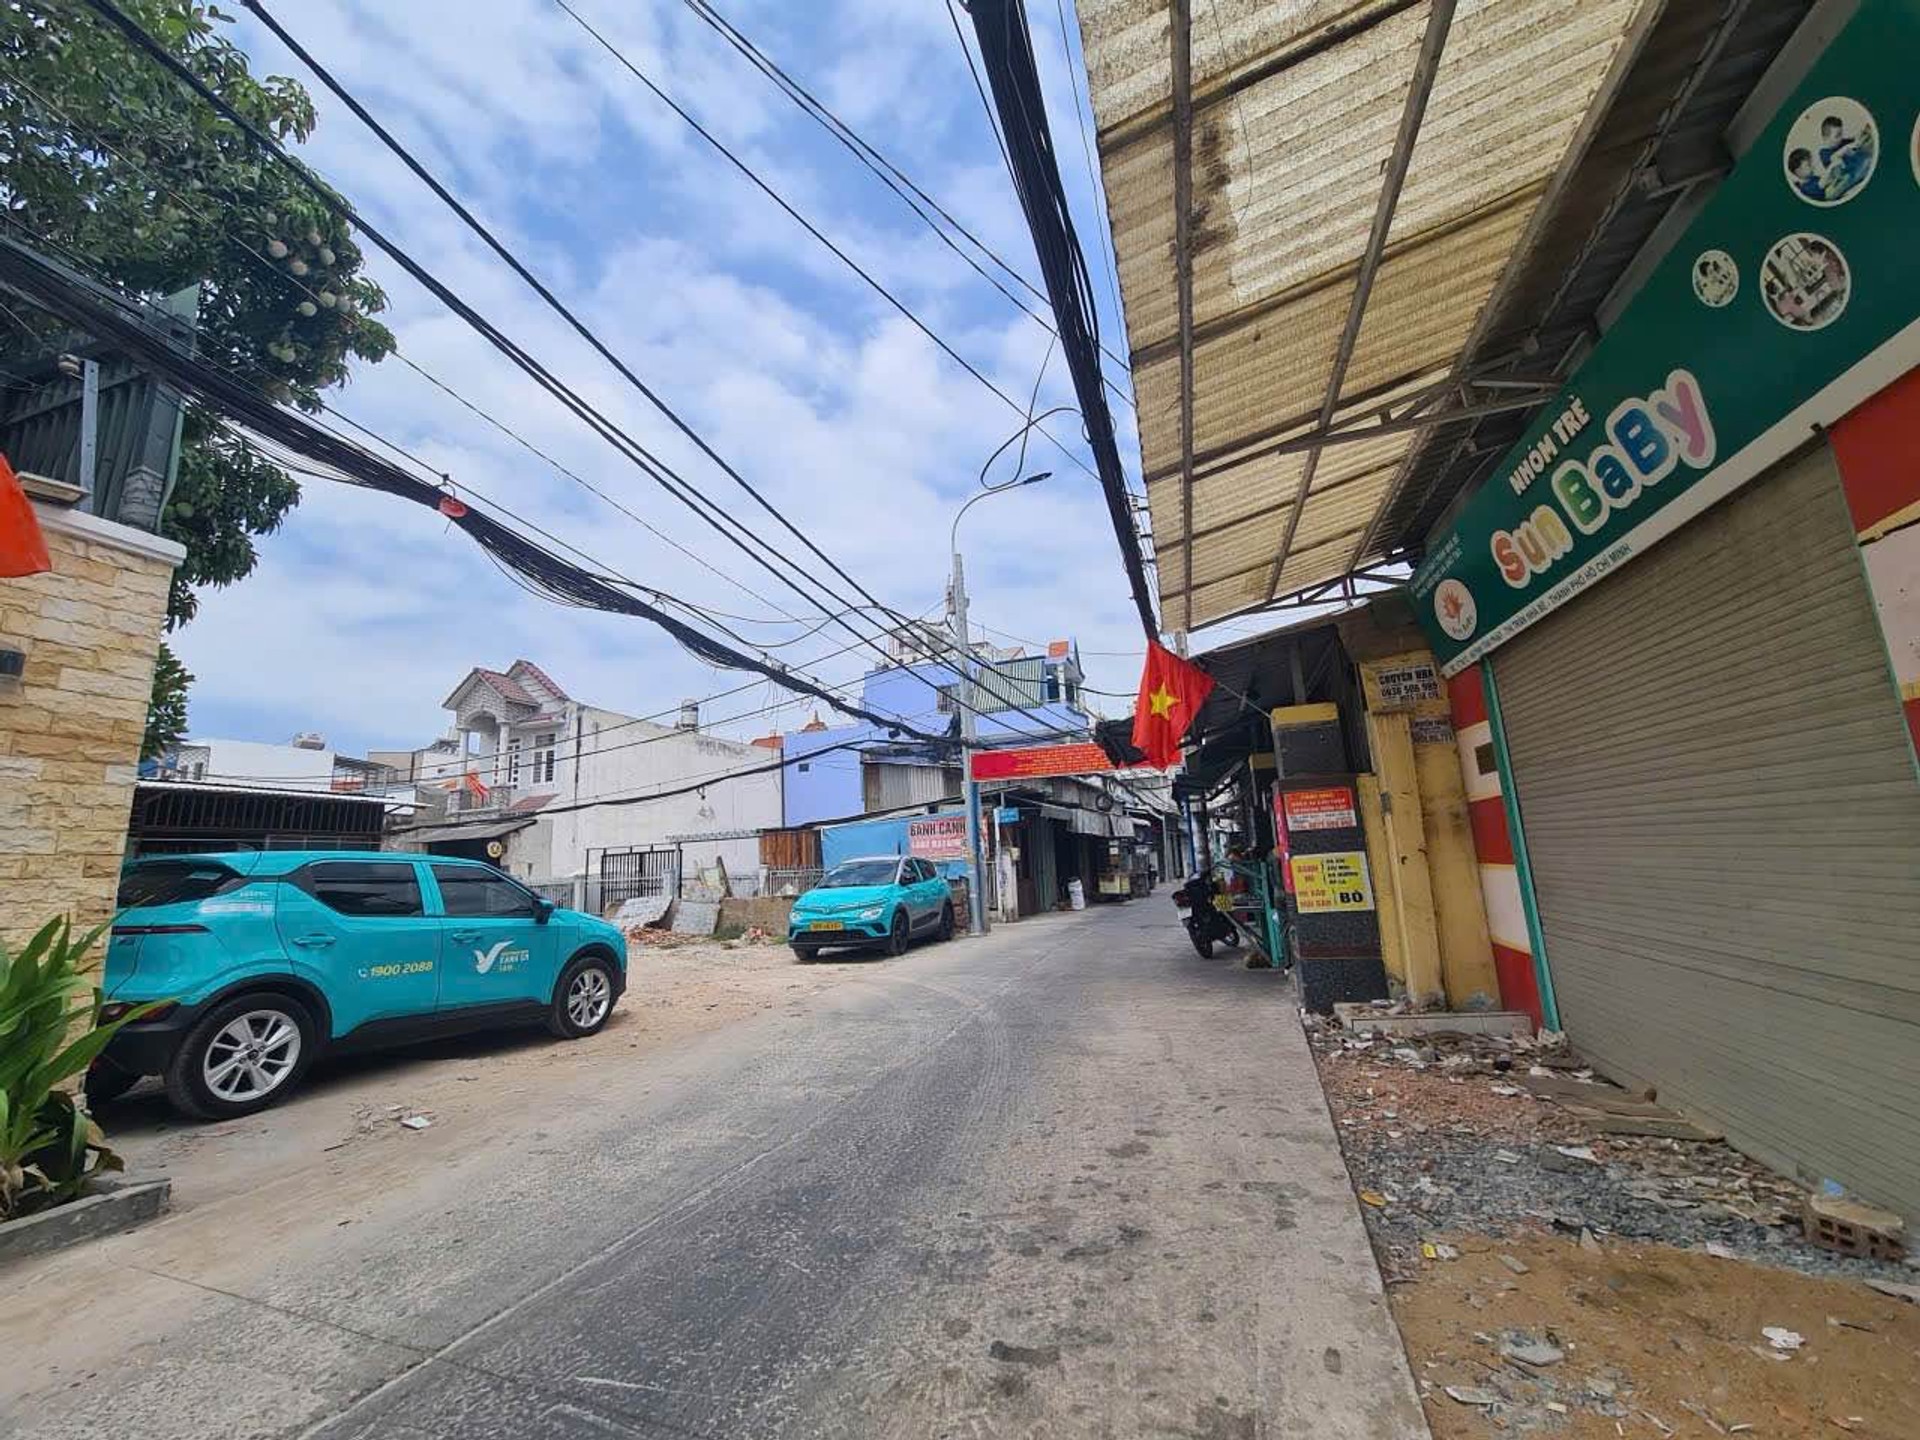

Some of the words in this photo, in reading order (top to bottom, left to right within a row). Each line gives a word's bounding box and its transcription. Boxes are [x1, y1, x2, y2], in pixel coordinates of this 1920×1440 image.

[1492, 506, 1572, 587] Sun
[1548, 586, 1572, 607] THÀNH
[1570, 574, 1586, 591] PHỐ
[1583, 563, 1597, 580] HỒ
[1596, 554, 1611, 574] CHÍ
[1608, 543, 1632, 564] MINH
[370, 964, 401, 978] 1900
[402, 960, 434, 974] 2088
